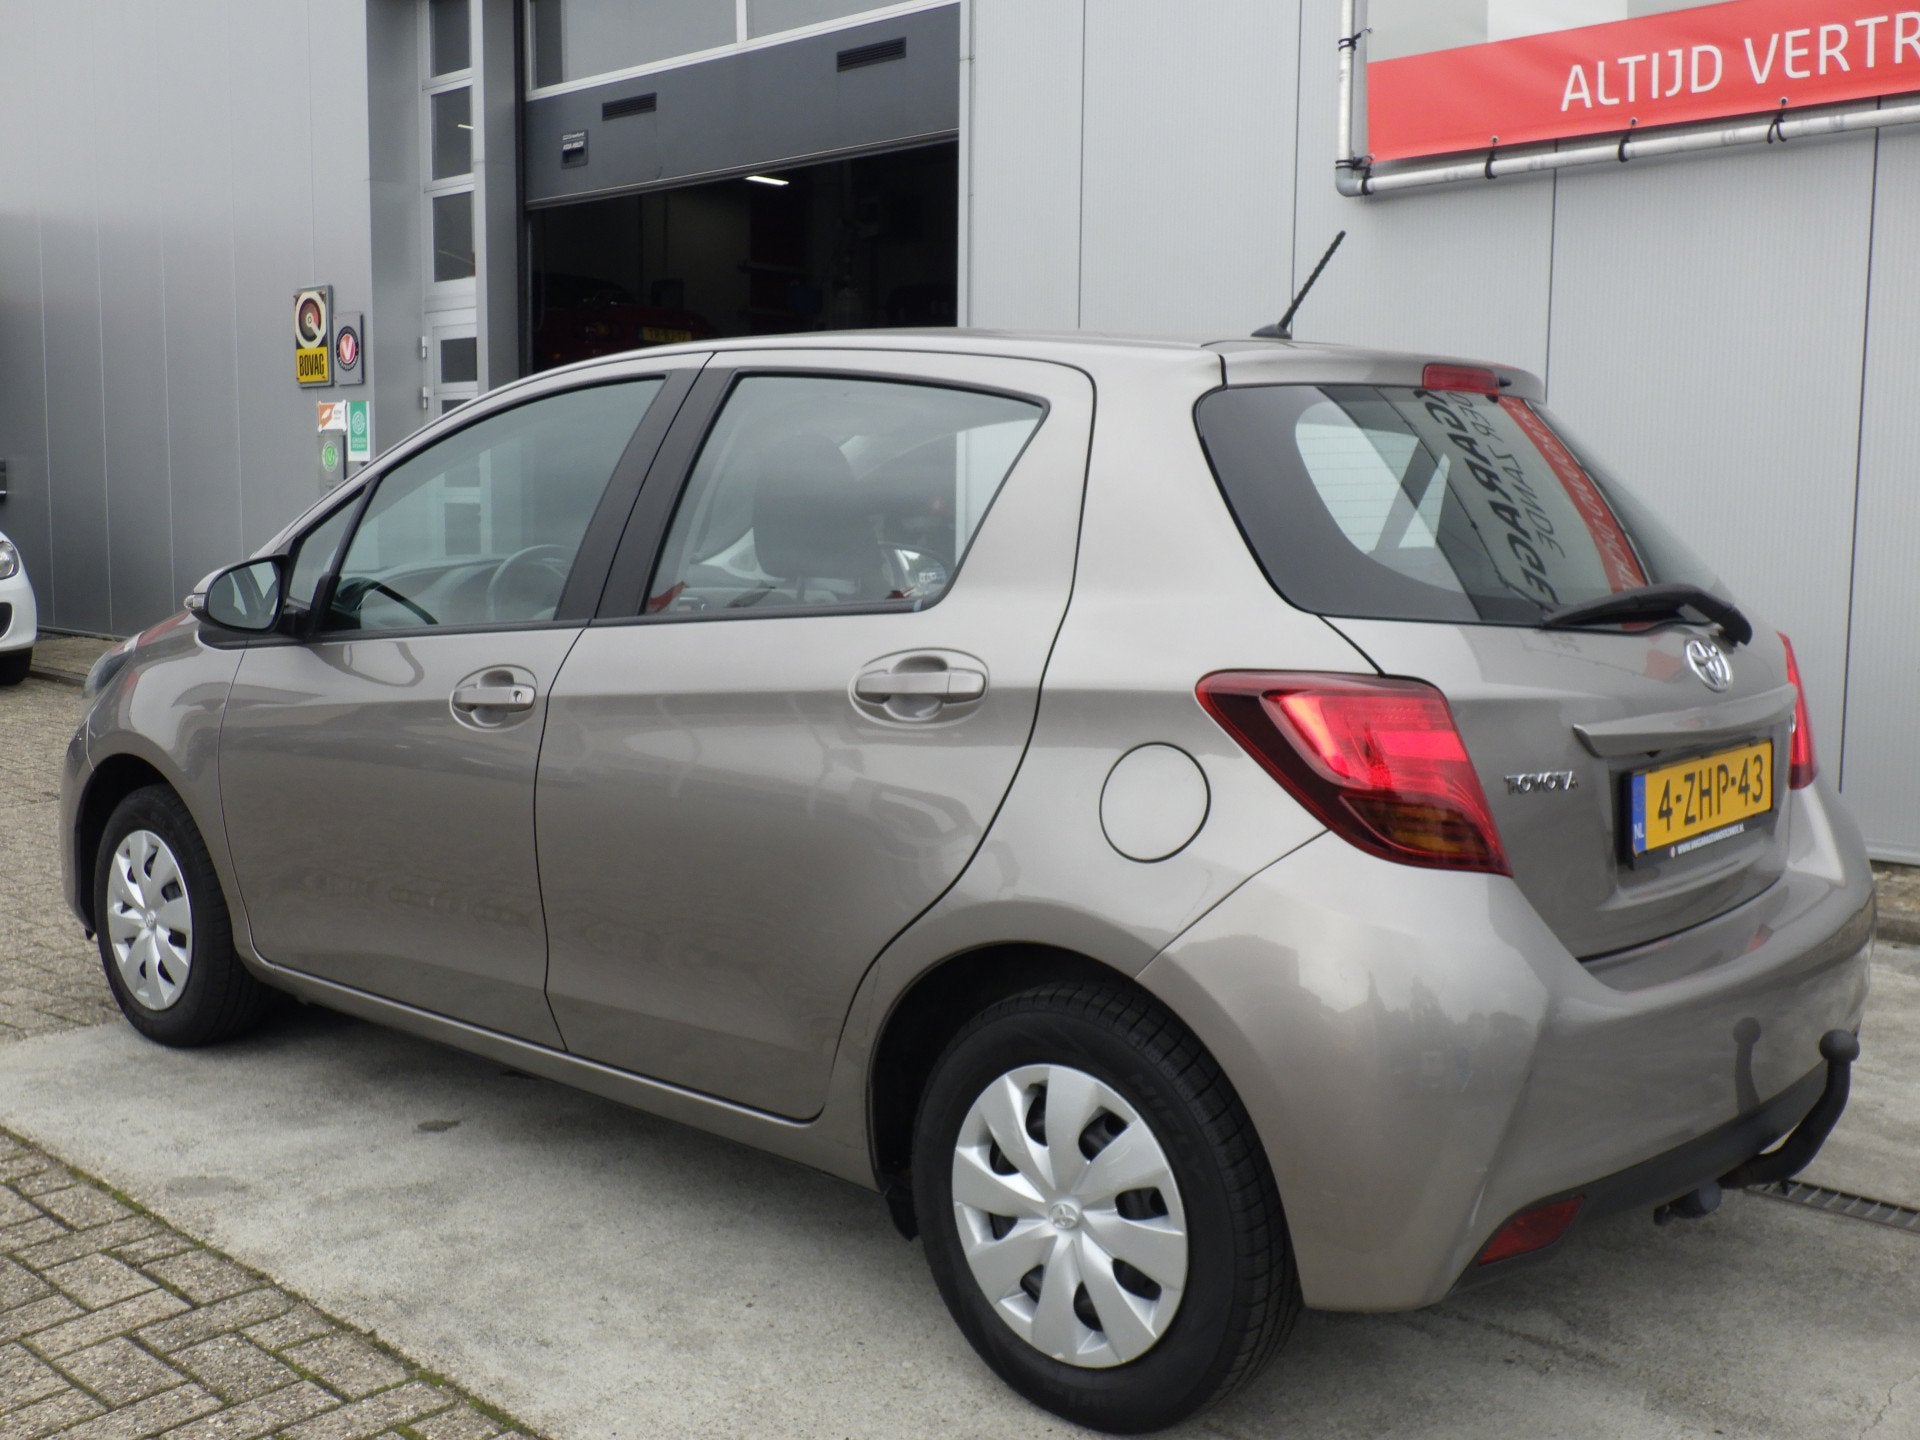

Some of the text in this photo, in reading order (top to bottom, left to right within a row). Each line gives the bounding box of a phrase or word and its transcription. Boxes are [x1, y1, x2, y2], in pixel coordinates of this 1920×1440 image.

[1561, 11, 1920, 112] ALTIJD VERTR
[299, 353, 325, 377] BOVAG
[1503, 771, 1578, 794] TOYOTA
[1657, 753, 1765, 832] 4-ZHP-43
